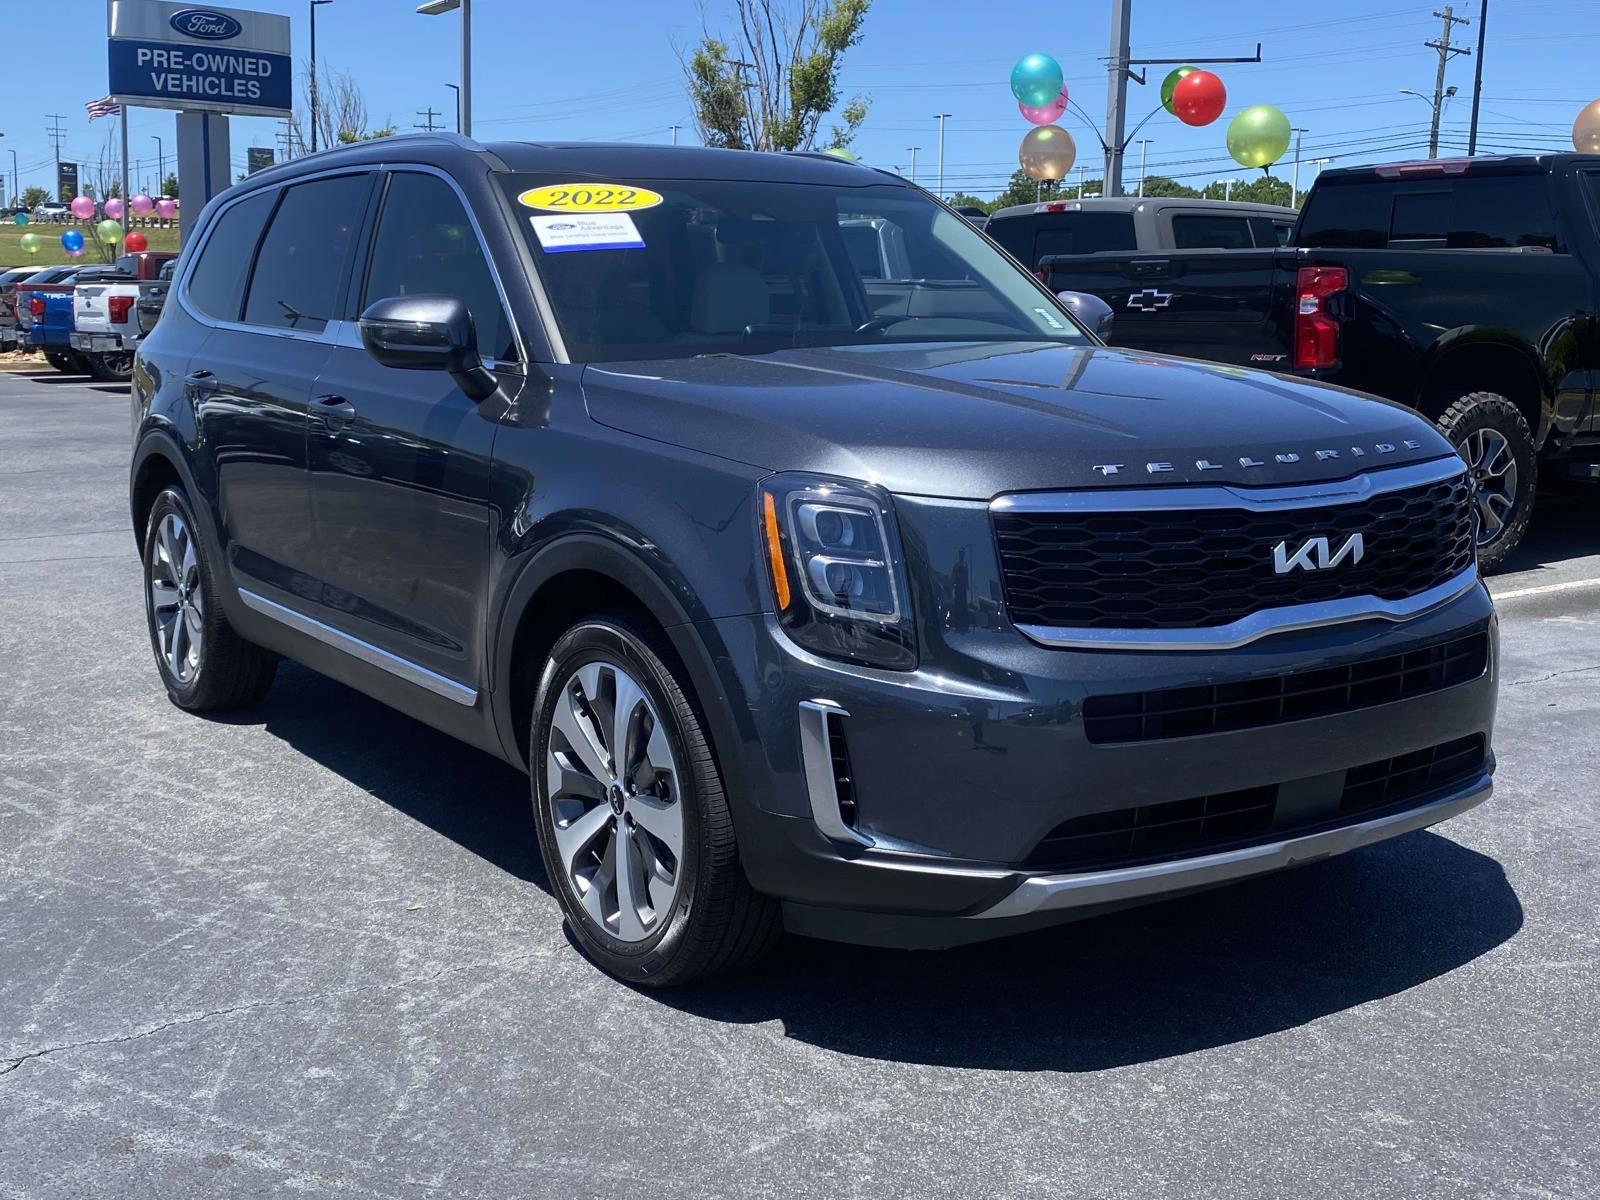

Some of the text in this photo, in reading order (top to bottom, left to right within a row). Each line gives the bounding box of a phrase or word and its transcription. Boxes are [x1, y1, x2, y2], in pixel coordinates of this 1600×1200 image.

[187, 15, 226, 35] Ford
[137, 48, 272, 77] PRE-OWNED
[151, 72, 261, 99] VEHICLES
[548, 190, 637, 206] 2022
[1092, 439, 1422, 476] TELLURIDE
[1273, 532, 1364, 574] KIA
